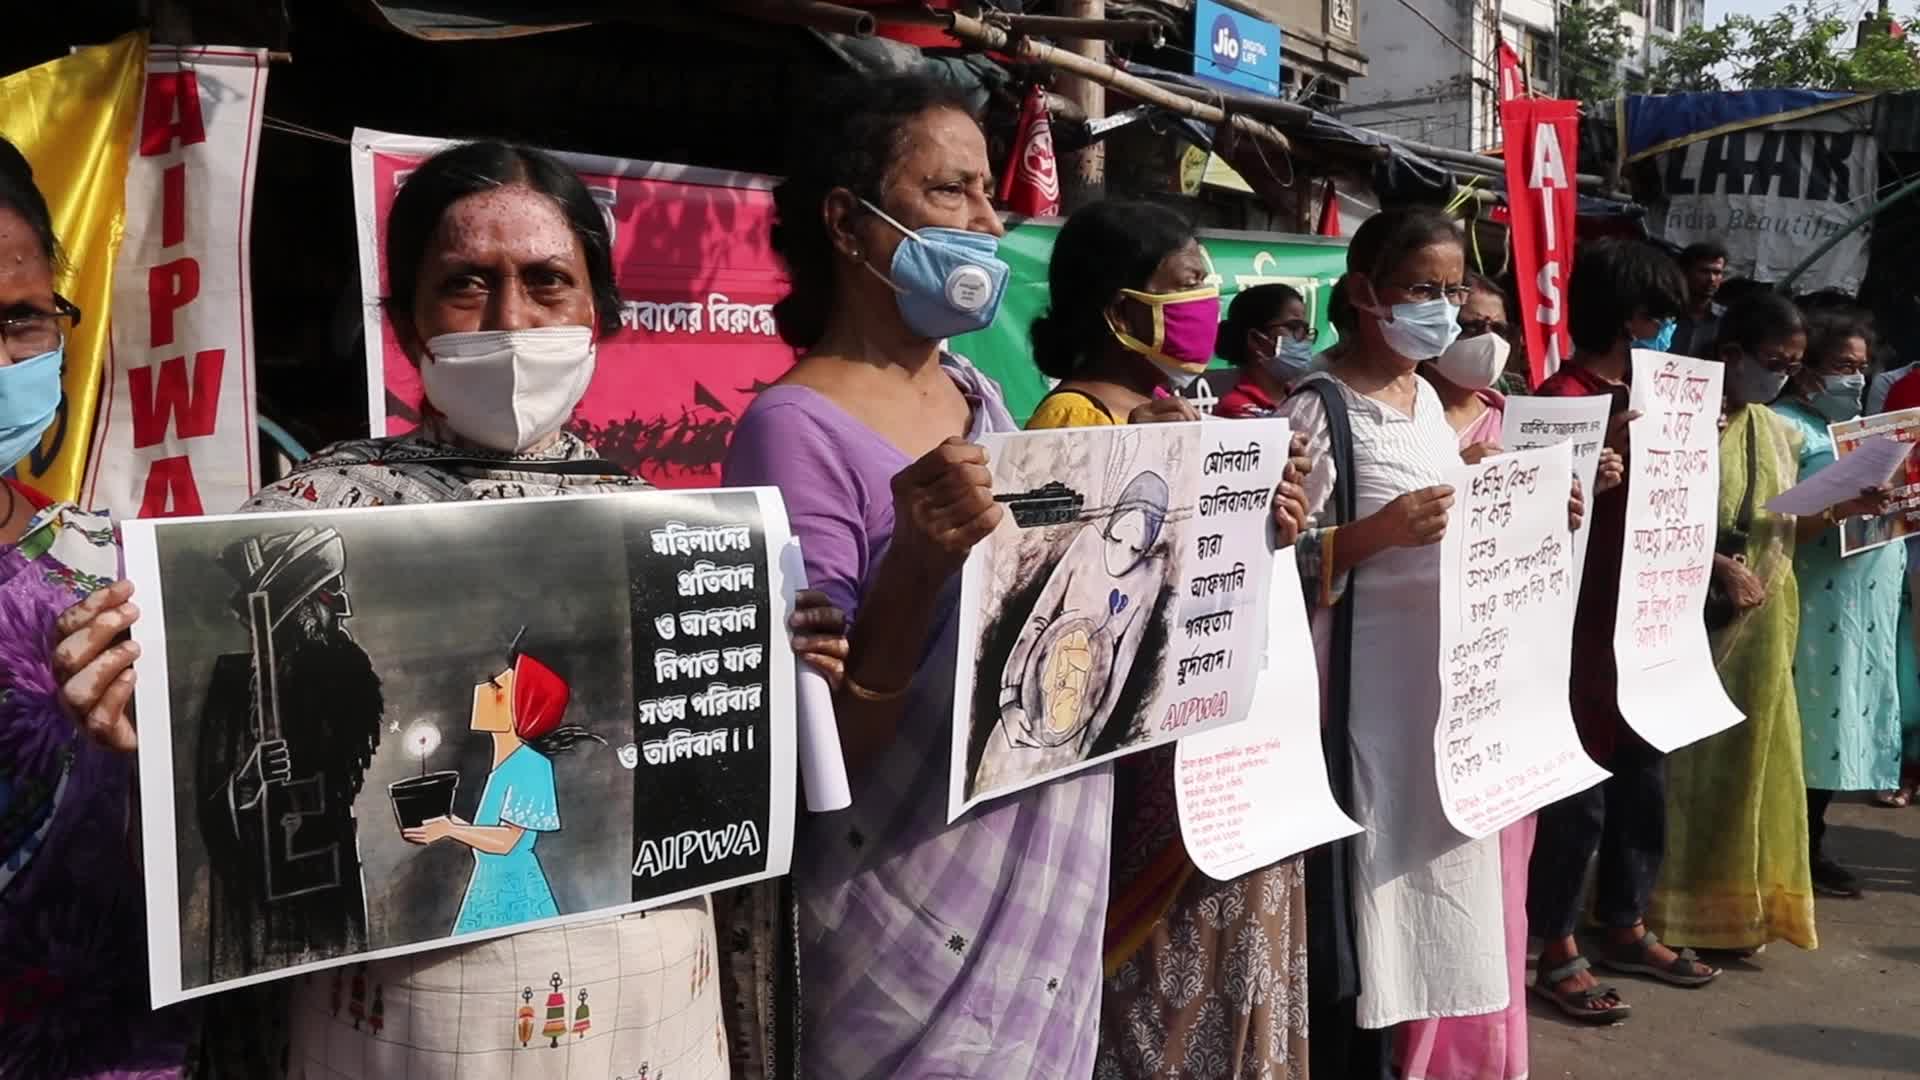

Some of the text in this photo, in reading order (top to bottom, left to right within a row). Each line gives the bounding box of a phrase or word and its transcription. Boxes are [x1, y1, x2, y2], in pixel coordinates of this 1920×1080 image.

[1213, 27, 1239, 58] Jio
[129, 70, 226, 519] AIPWA
[619, 300, 704, 335] লবাদের
[650, 520, 751, 556] মহিলাদের
[677, 560, 754, 596] প্রতিবাদ
[654, 613, 675, 640] ও
[654, 643, 763, 683] নিপাত যাক
[691, 681, 763, 716] পরিবার
[1160, 690, 1228, 731] AIPWA
[616, 743, 638, 769] ও
[632, 820, 760, 877] AIPWA
